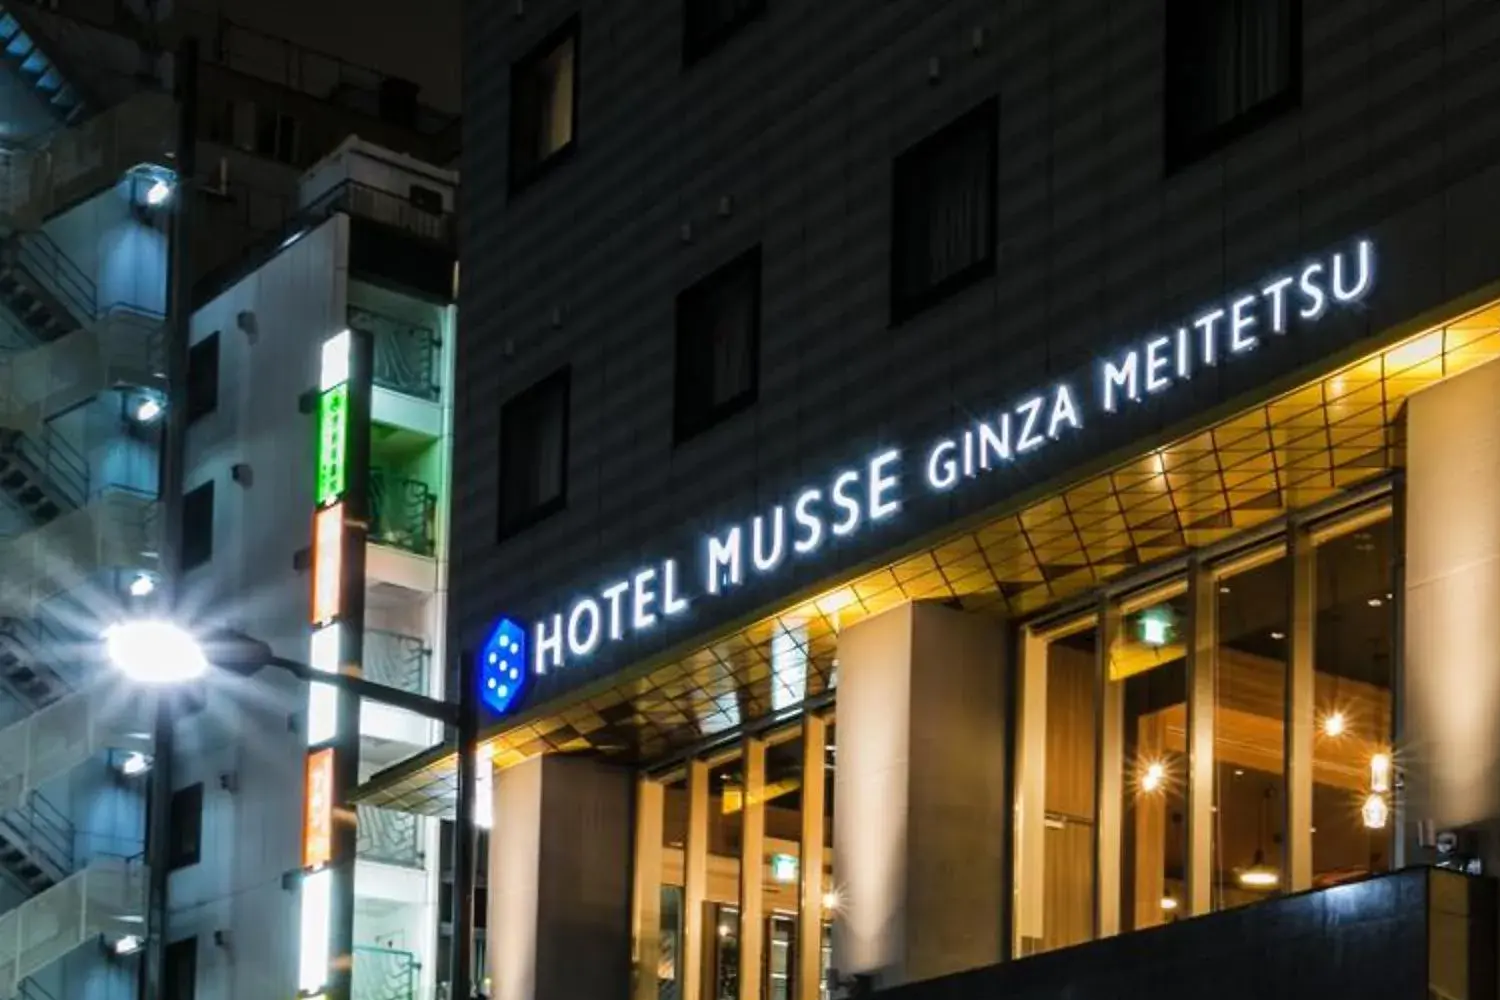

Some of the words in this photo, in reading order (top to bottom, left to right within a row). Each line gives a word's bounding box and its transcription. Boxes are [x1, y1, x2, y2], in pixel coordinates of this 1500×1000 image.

[536, 560, 686, 673] HOTEL
[708, 450, 898, 593] MUSSE
[928, 385, 1077, 488] GINZA
[1104, 241, 1368, 410] MEITETSU
